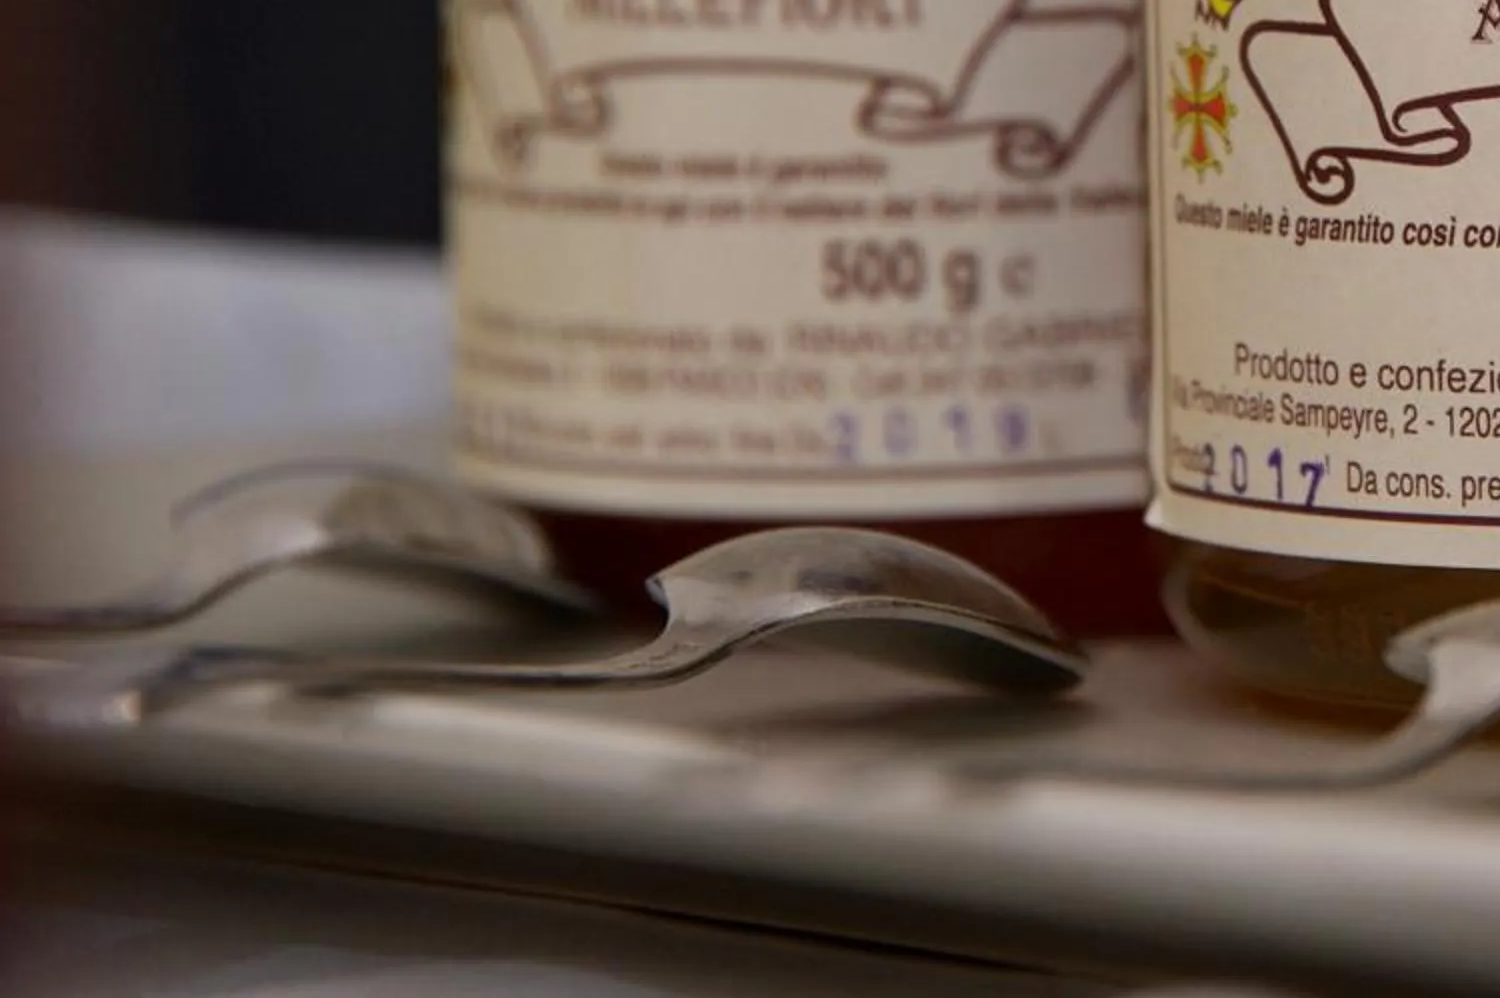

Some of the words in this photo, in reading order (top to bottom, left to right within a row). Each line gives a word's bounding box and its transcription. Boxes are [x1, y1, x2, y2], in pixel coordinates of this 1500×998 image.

[1226, 204, 1273, 236] miele
[1278, 208, 1290, 238] è
[1294, 213, 1396, 247] garantito
[1402, 215, 1457, 247] così
[819, 237, 926, 303] 500
[1235, 341, 1340, 387] Prodotto
[1350, 361, 1368, 389] e
[1279, 392, 1395, 440] Sampeyre,
[1402, 403, 1419, 435] 2
[1346, 460, 1378, 496] Da
[1385, 471, 1451, 500] cons.
